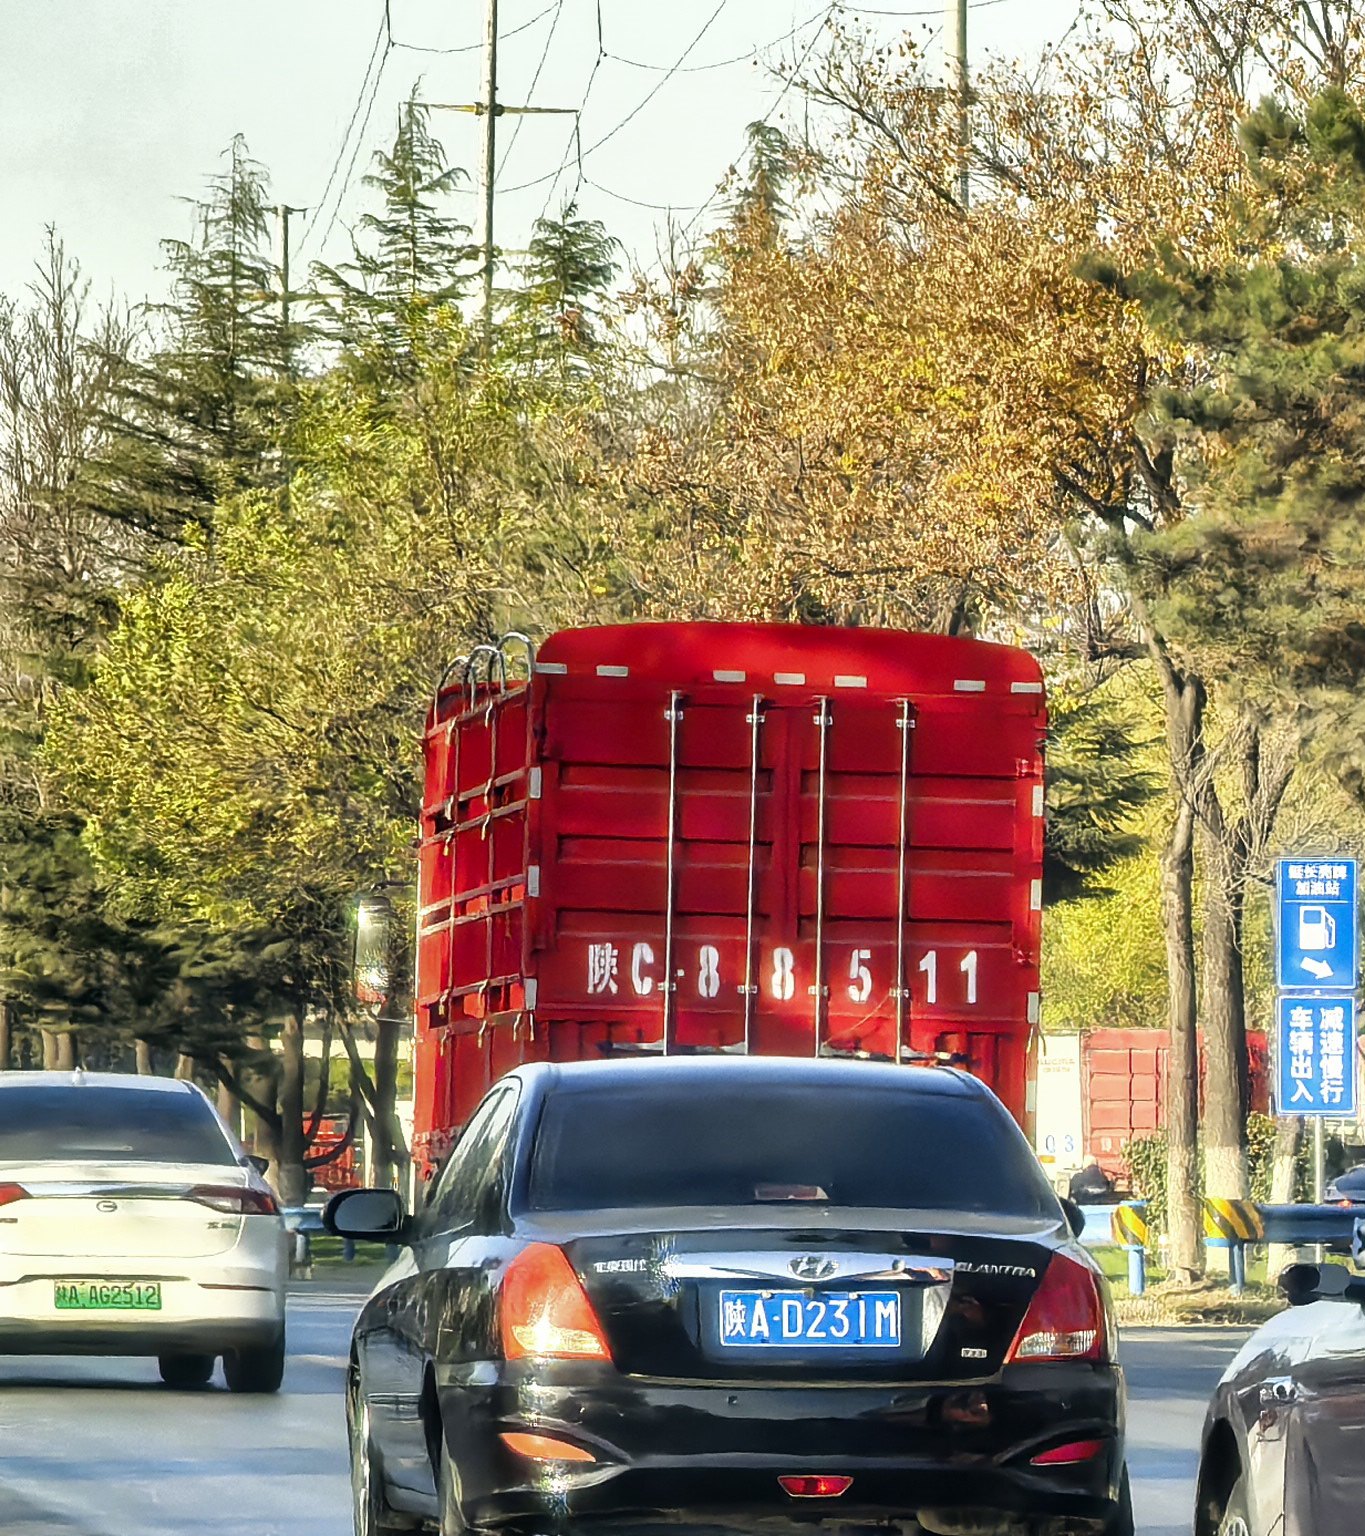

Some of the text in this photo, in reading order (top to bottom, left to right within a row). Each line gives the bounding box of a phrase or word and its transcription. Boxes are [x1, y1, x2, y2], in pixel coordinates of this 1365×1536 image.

[1295, 880, 1340, 896] 加油站
[1289, 1005, 1314, 1103] 车辆出入
[1319, 1006, 1344, 1104] 减速慢行
